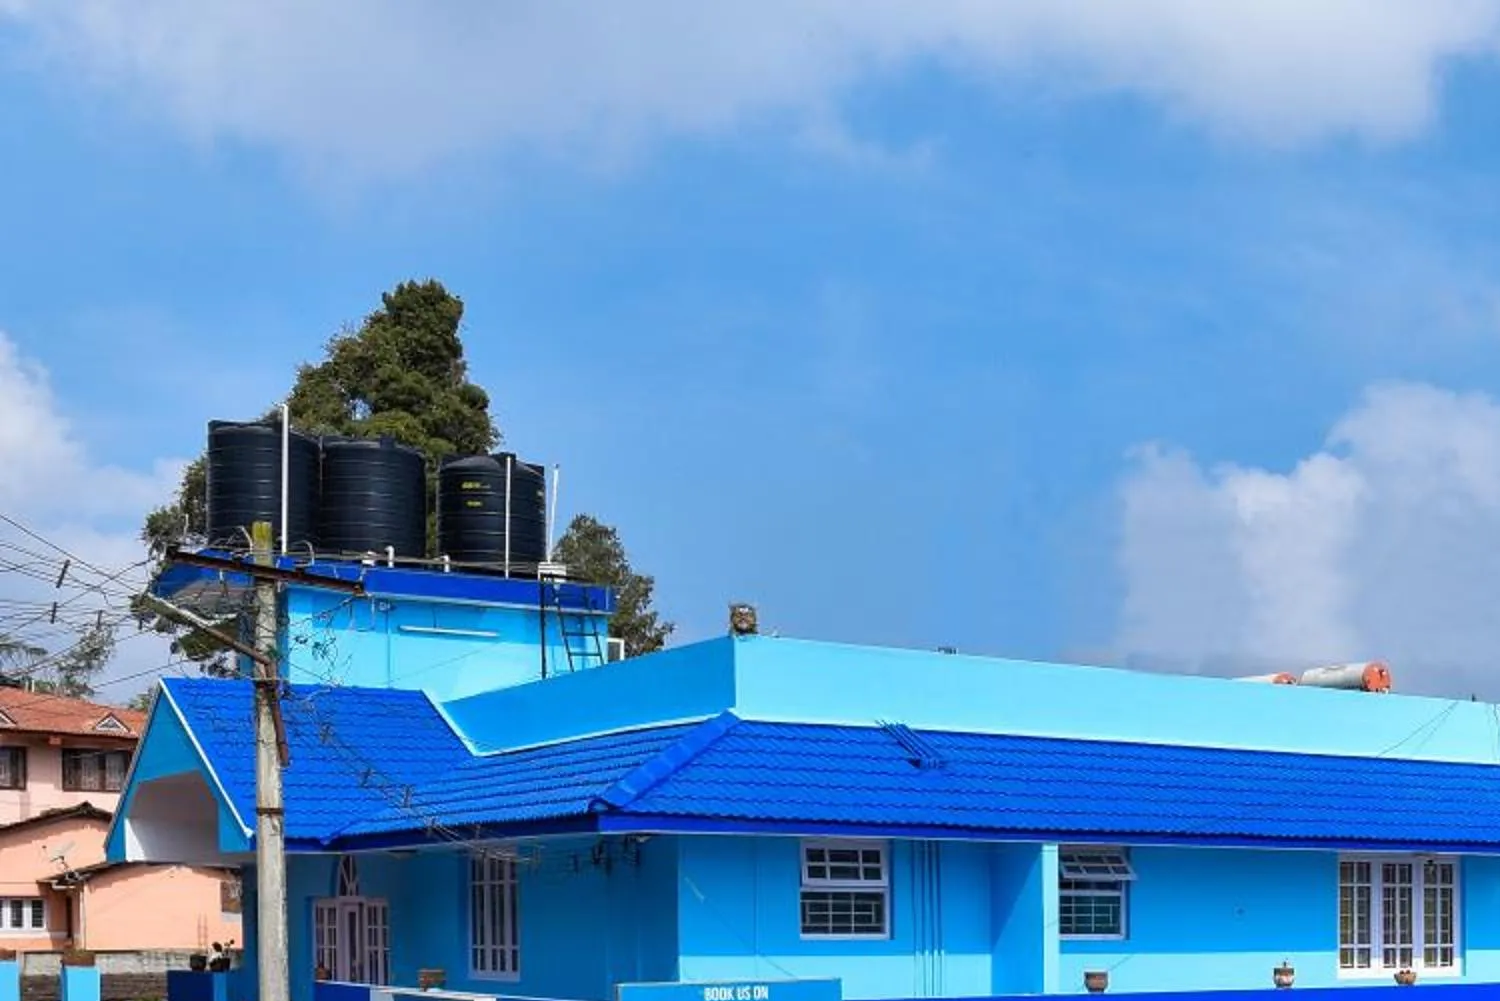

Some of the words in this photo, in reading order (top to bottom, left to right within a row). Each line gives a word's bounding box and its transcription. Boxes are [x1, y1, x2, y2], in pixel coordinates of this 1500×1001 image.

[704, 986, 735, 1001] BOOK
[737, 985, 751, 1001] US
[753, 984, 769, 1000] ON
